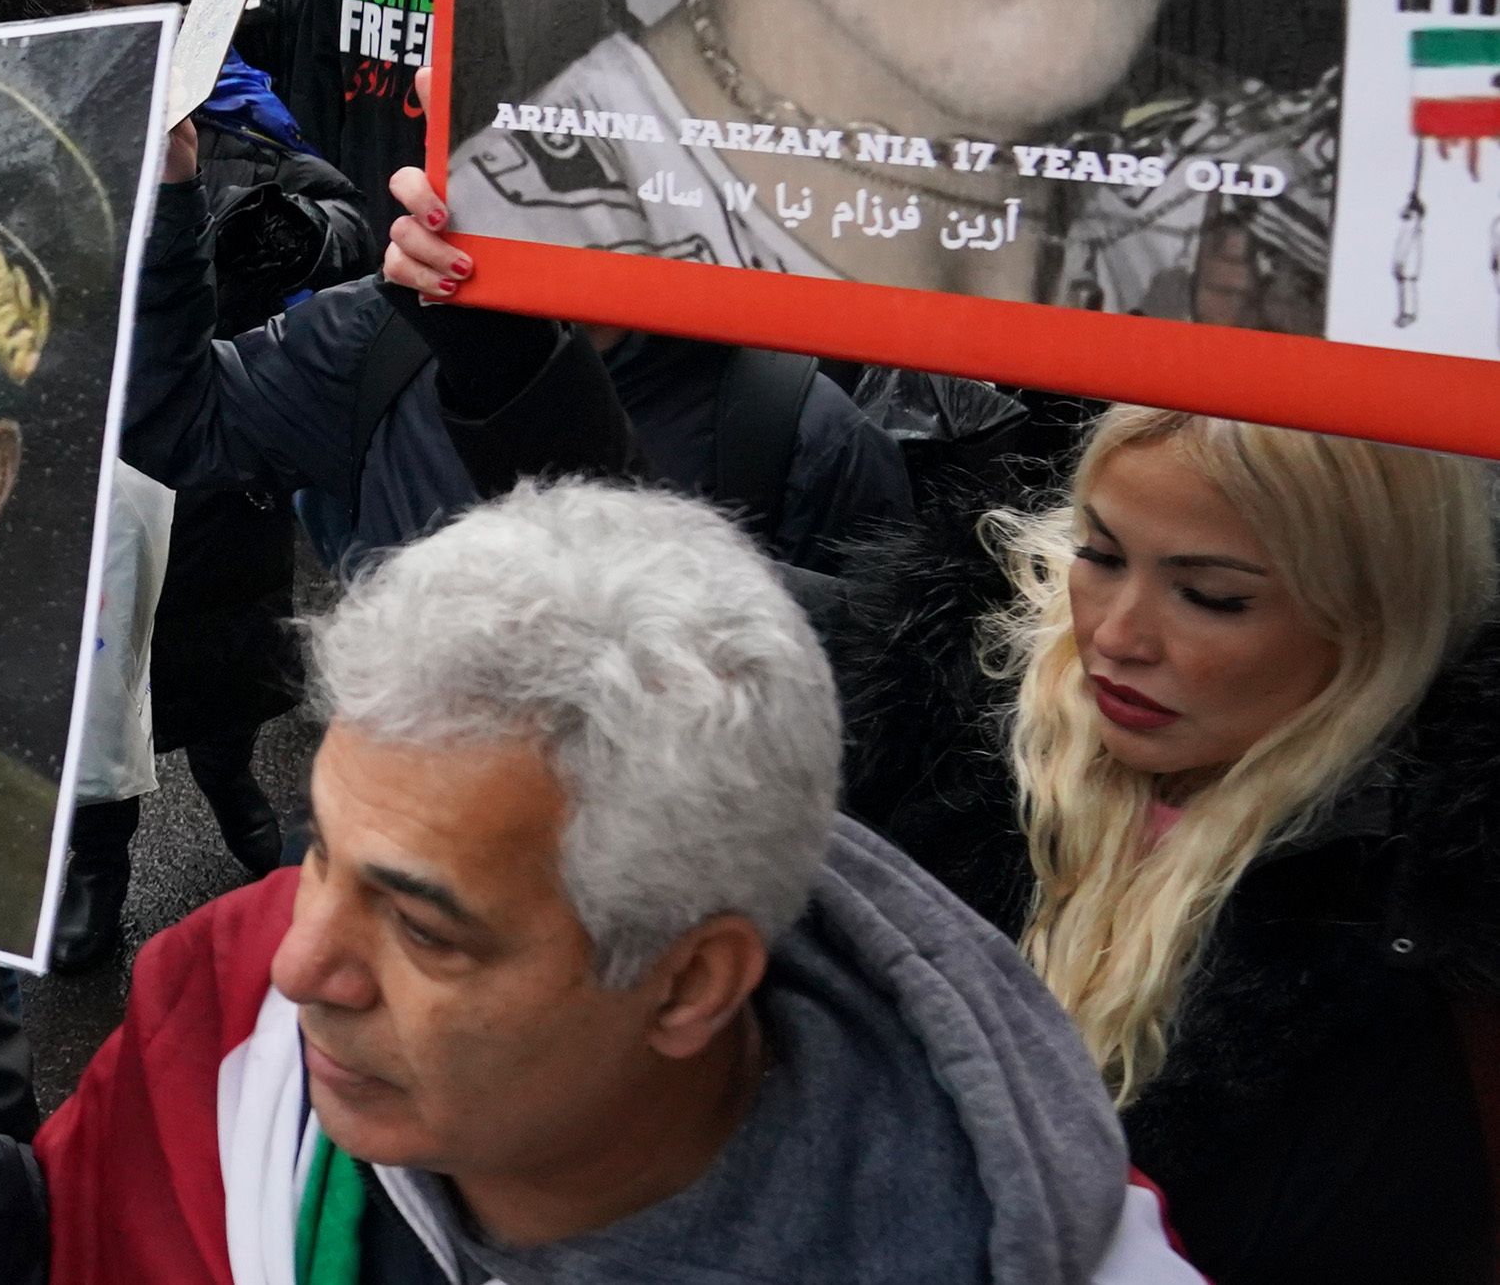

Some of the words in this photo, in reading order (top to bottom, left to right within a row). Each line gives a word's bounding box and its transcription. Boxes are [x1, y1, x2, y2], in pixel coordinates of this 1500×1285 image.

[491, 102, 665, 143] ARIANNA
[678, 117, 845, 161] FARZAM
[856, 133, 937, 169] NIA
[952, 140, 997, 172] 17
[1012, 145, 1168, 188] YEARS
[1184, 159, 1287, 198] OLD
[636, 169, 704, 208] ساله
[775, 181, 815, 227] نیا
[832, 189, 923, 240] فرزام
[939, 198, 1022, 251] آرین
